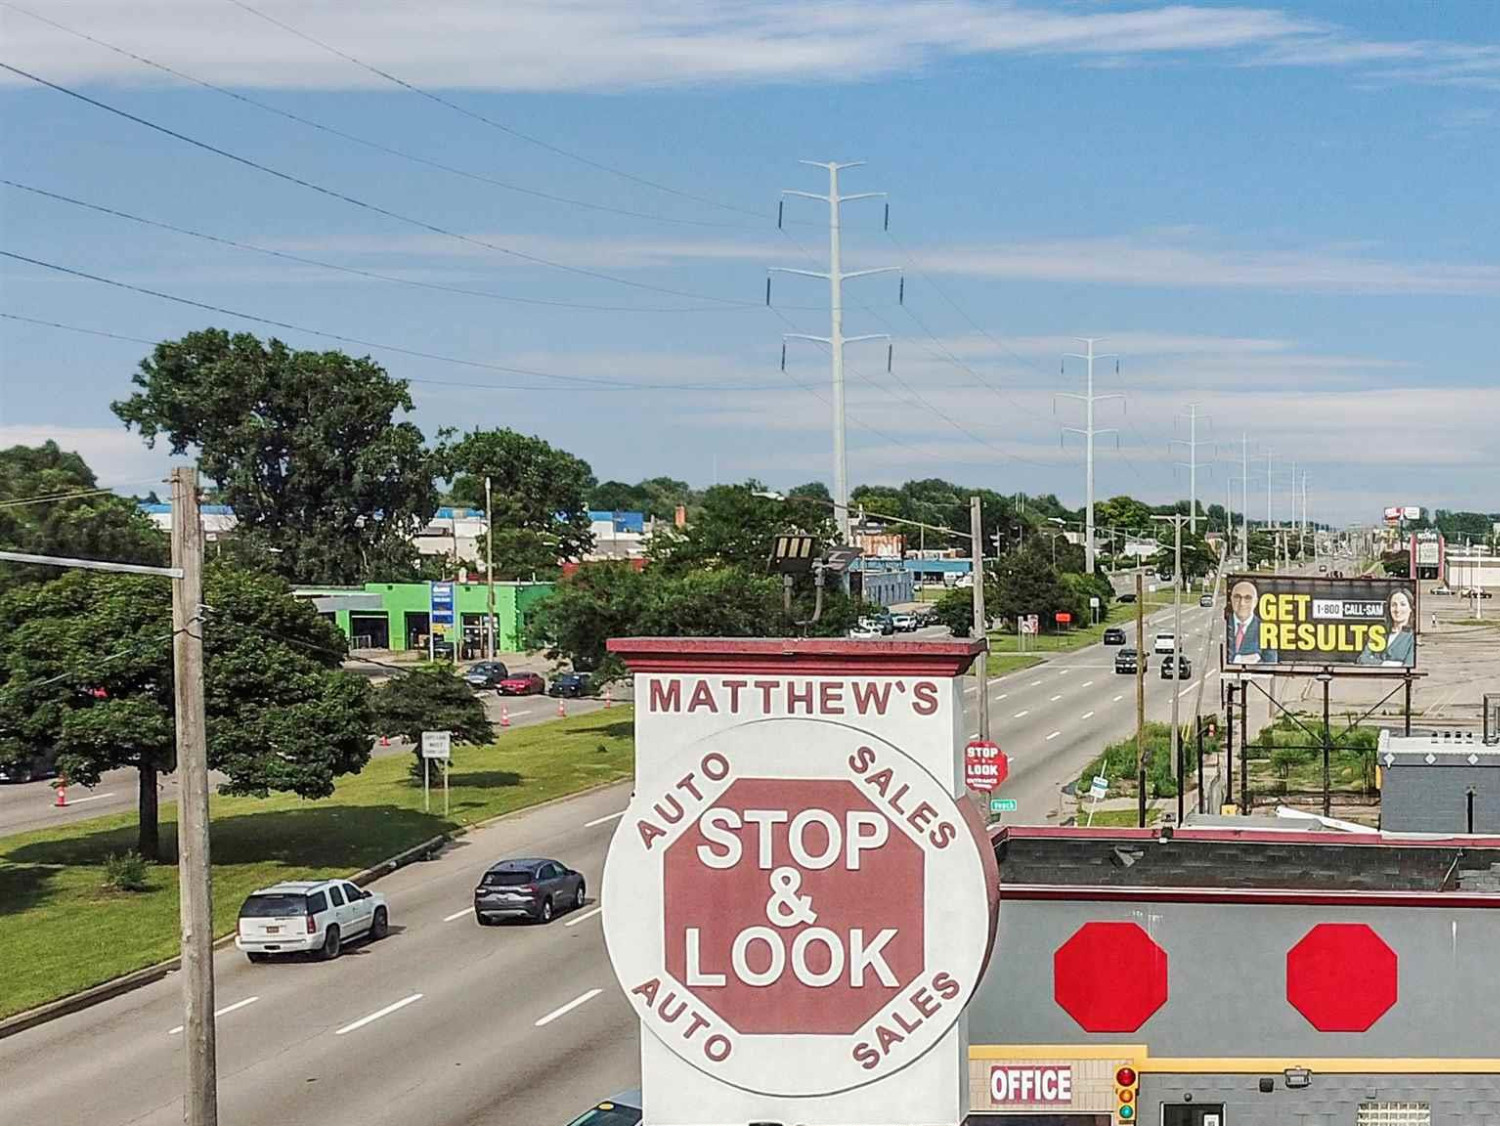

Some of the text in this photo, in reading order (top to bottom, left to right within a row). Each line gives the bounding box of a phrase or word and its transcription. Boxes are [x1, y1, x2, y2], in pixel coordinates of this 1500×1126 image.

[1259, 594, 1311, 620] GET
[1259, 623, 1387, 652] RESULTS
[649, 679, 938, 715] MATTHEW'S
[966, 747, 999, 758] STOP
[967, 764, 999, 775] LOOK
[637, 752, 730, 849] AUTO
[849, 746, 956, 850] SALES
[696, 808, 889, 870] STOP
[765, 866, 818, 928] &
[685, 927, 900, 988] LOOK
[631, 977, 732, 1063] AUTO
[851, 971, 960, 1070] SALES
[990, 1069, 1072, 1100] OFFICE
